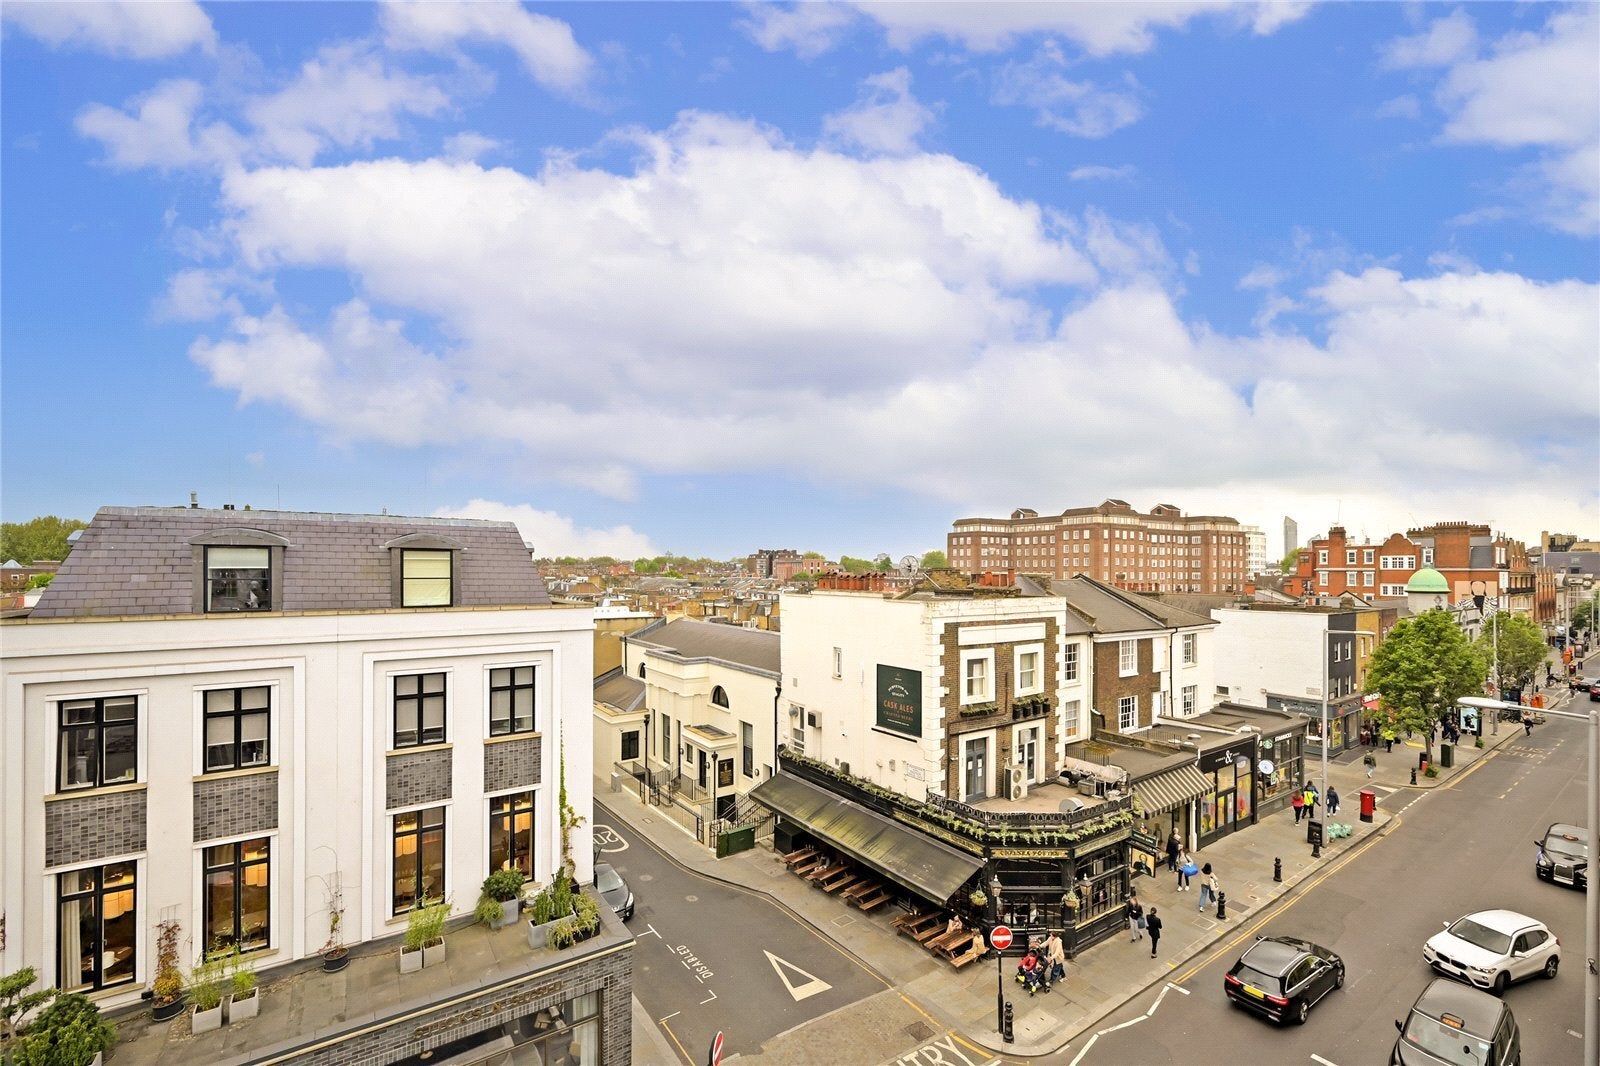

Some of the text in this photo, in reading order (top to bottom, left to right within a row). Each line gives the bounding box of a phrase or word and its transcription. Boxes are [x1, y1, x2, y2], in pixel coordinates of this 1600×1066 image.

[883, 700, 913, 713] CASK ALES
[1225, 750, 1233, 764] &
[676, 944, 714, 979] DISABLED
